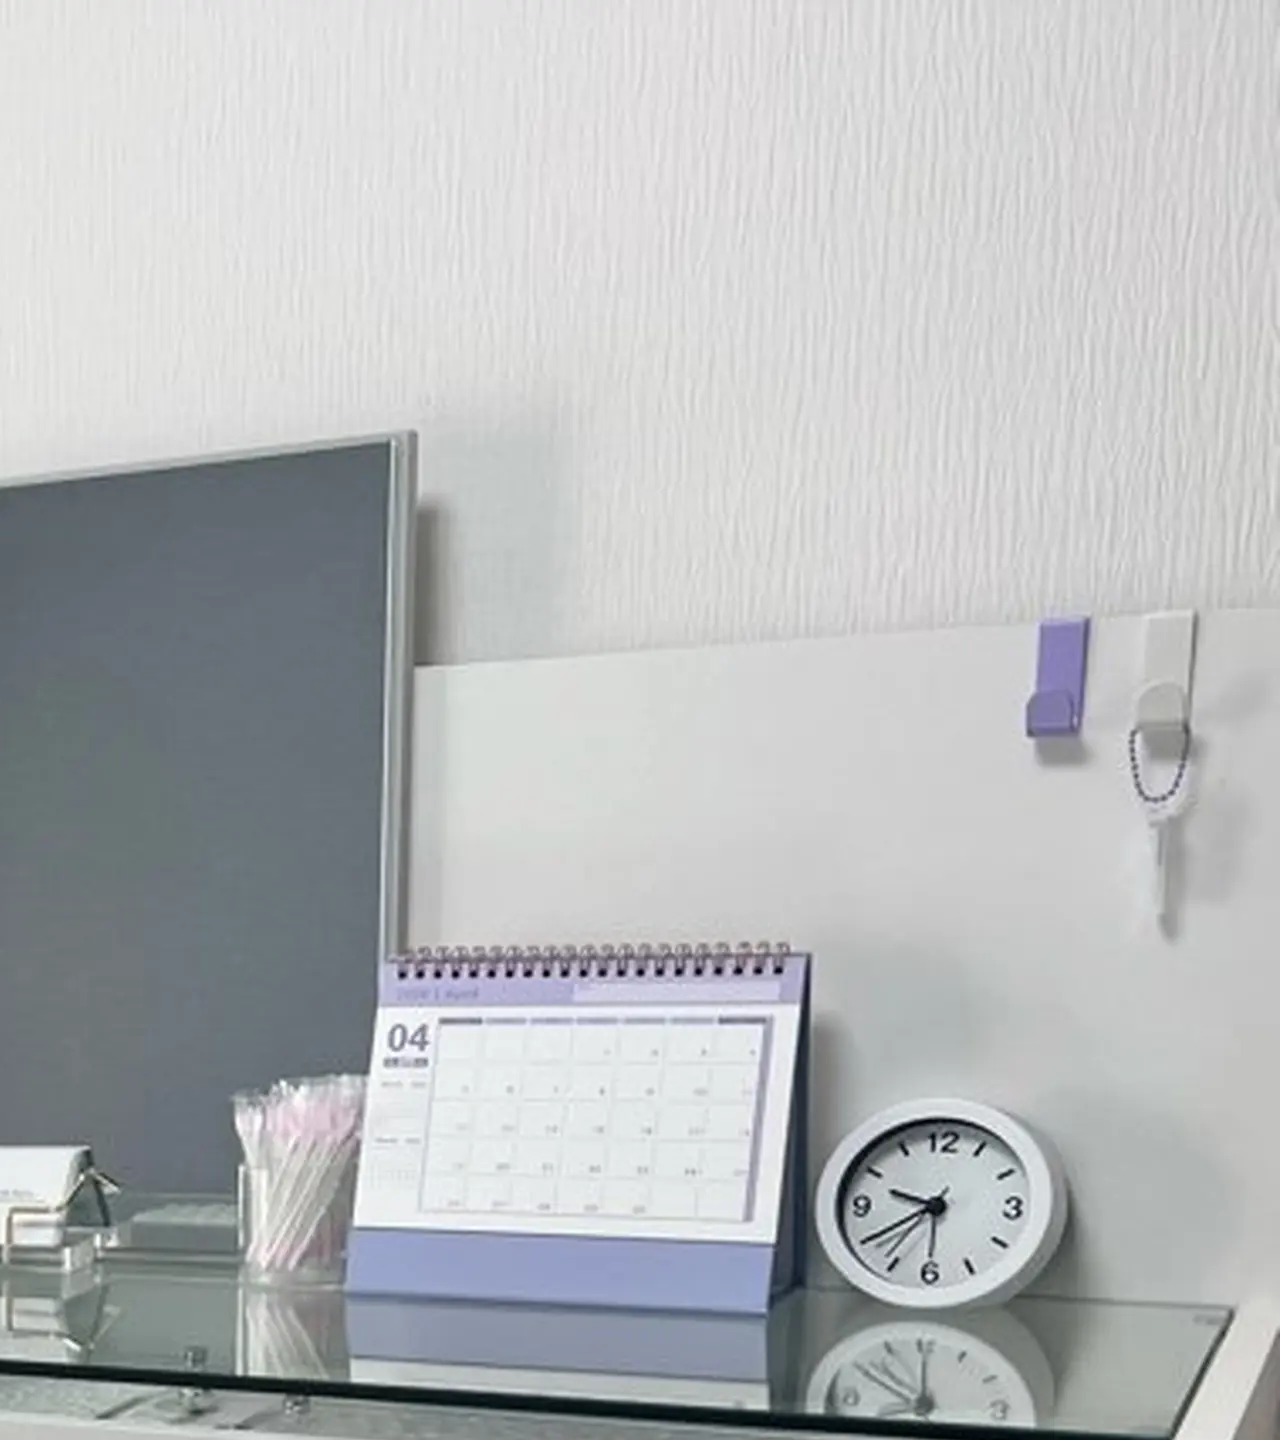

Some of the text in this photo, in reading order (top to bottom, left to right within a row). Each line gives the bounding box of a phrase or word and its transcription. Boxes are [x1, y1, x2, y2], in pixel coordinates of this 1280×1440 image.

[387, 1023, 431, 1053] 04
[928, 1131, 960, 1153] 12
[853, 1195, 872, 1218] 9
[1002, 1196, 1023, 1220] 3
[921, 1261, 939, 1285] 6
